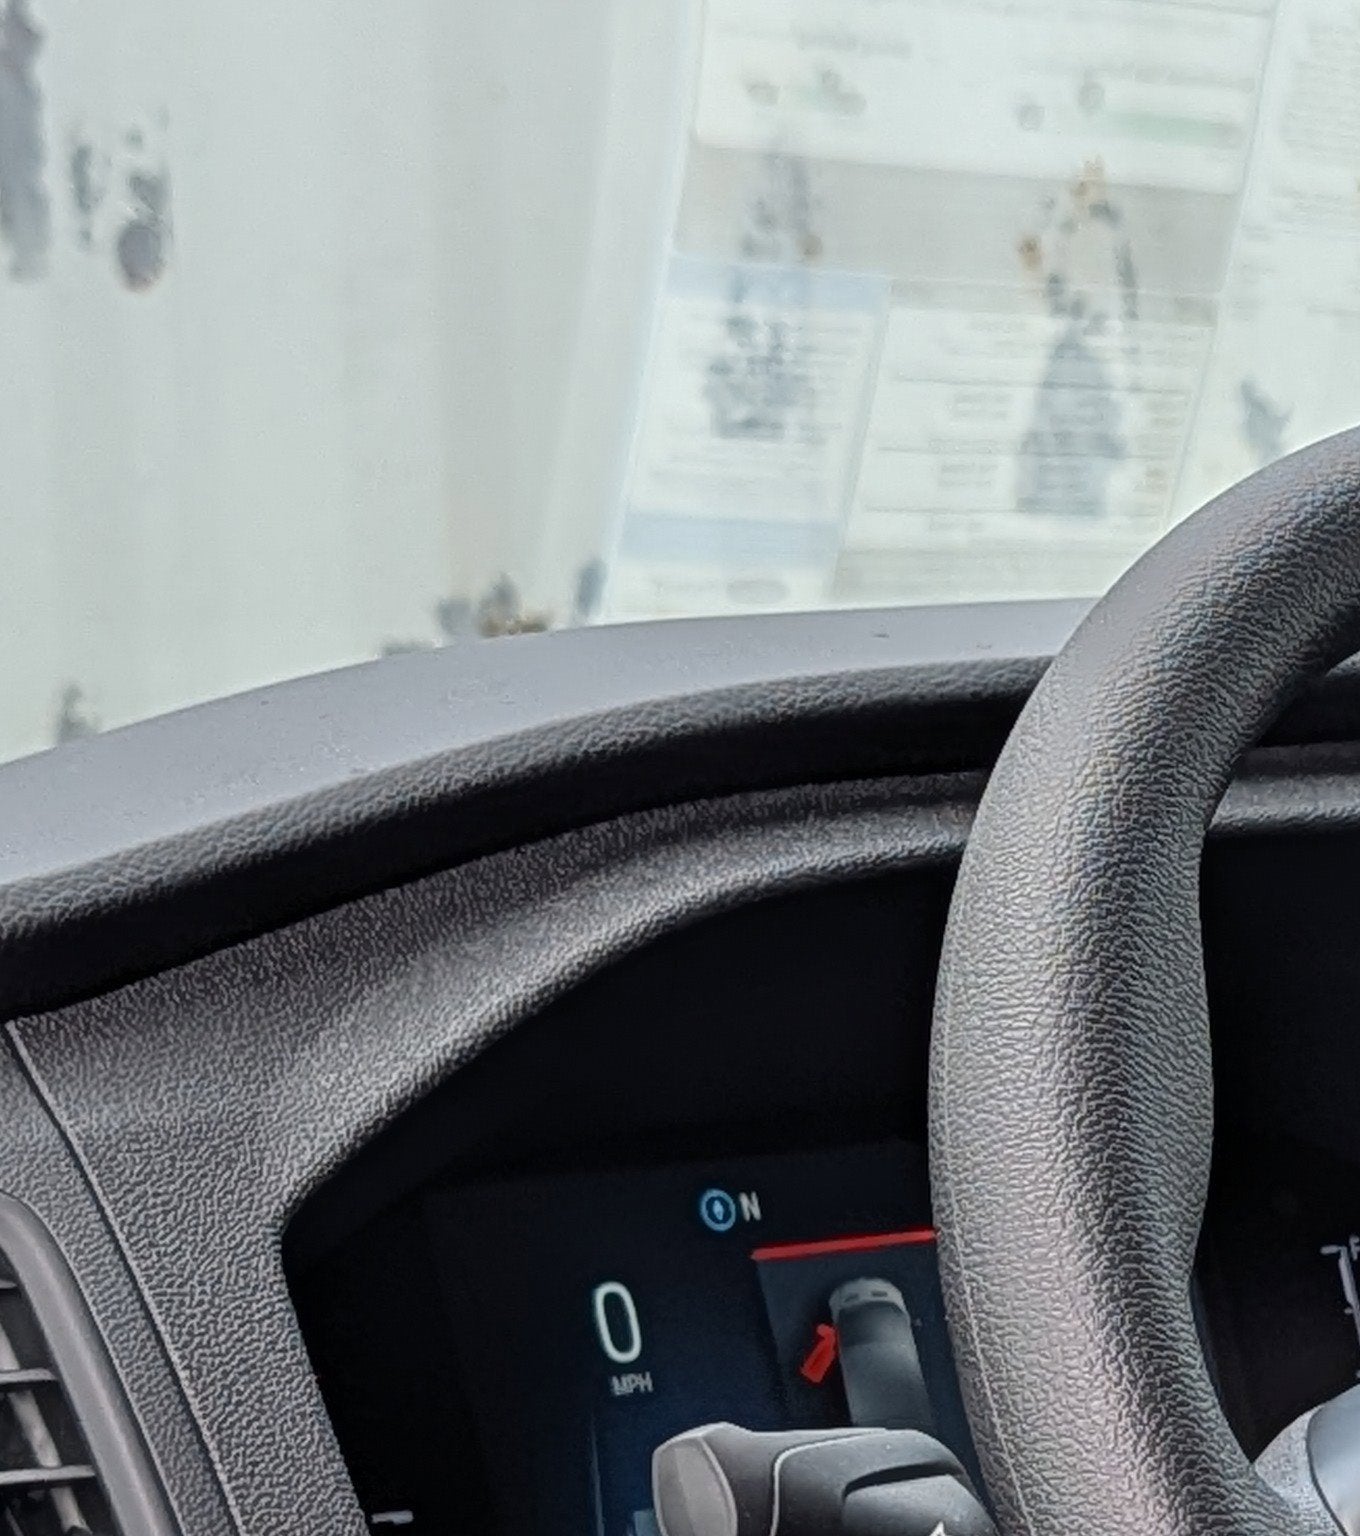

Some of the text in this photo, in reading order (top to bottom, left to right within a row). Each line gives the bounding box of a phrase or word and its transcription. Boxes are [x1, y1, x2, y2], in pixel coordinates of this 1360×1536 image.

[738, 1190, 763, 1222] N
[595, 1281, 641, 1363] 0
[611, 1371, 654, 1396] MPH
